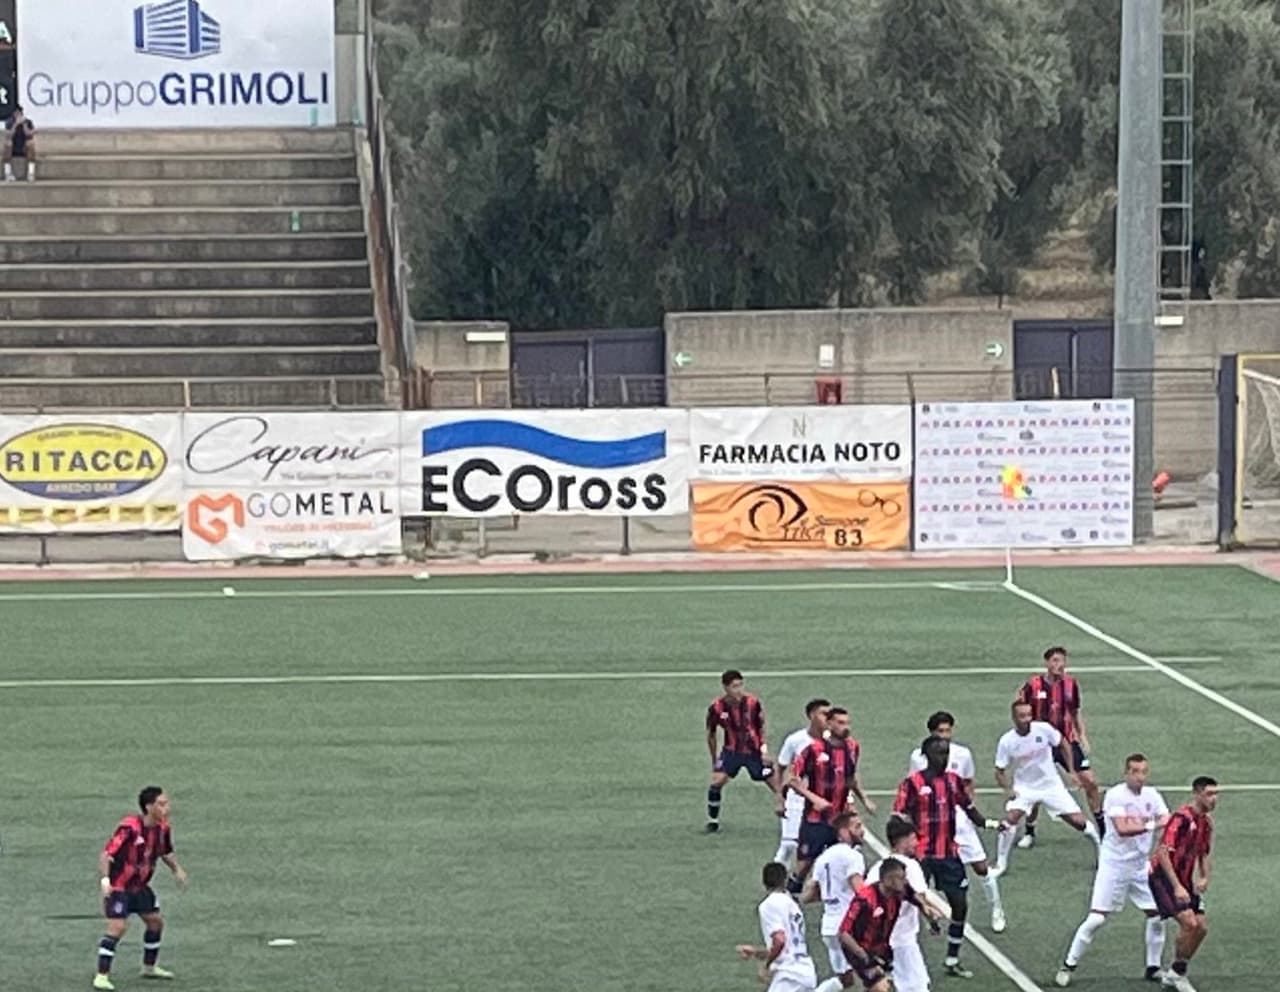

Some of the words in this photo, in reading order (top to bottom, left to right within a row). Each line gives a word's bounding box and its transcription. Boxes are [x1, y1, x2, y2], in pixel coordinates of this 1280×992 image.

[5, 450, 156, 472] RITACCA
[699, 444, 826, 464] FARMACIA
[834, 442, 901, 462] NOTO
[421, 458, 667, 512] ECOross
[247, 491, 394, 517] GOMETAL
[834, 529, 863, 547] 83
